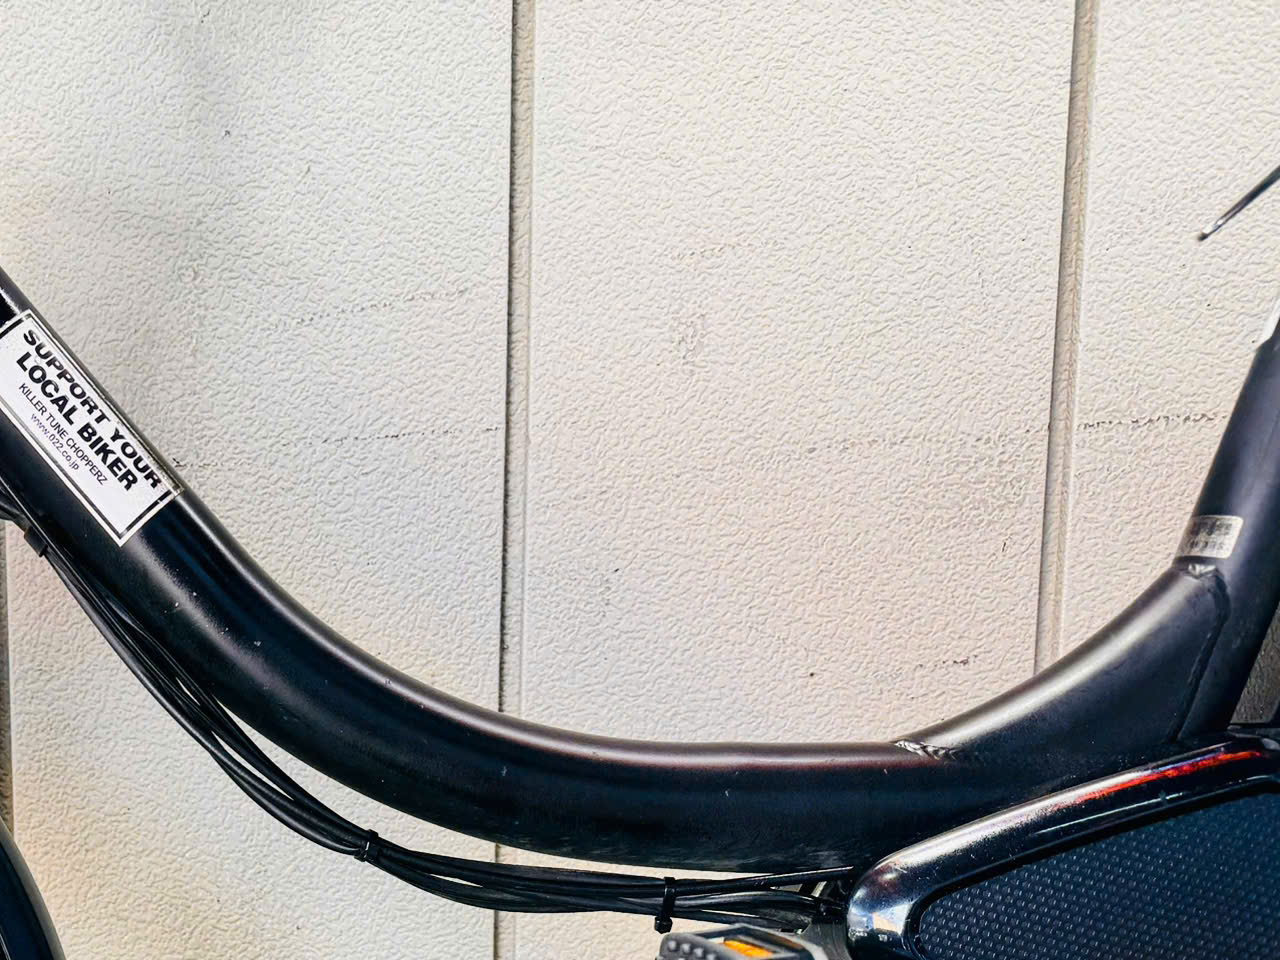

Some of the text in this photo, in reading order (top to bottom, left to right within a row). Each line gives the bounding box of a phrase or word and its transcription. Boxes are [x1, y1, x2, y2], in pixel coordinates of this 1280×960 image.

[16, 352, 138, 490] LOCAL BIKER
[18, 382, 108, 486] KILLER TUNE CHOPPERZ
[23, 329, 163, 489] SUPPORT YOUR
[30, 413, 81, 471] www.022.co.jp
